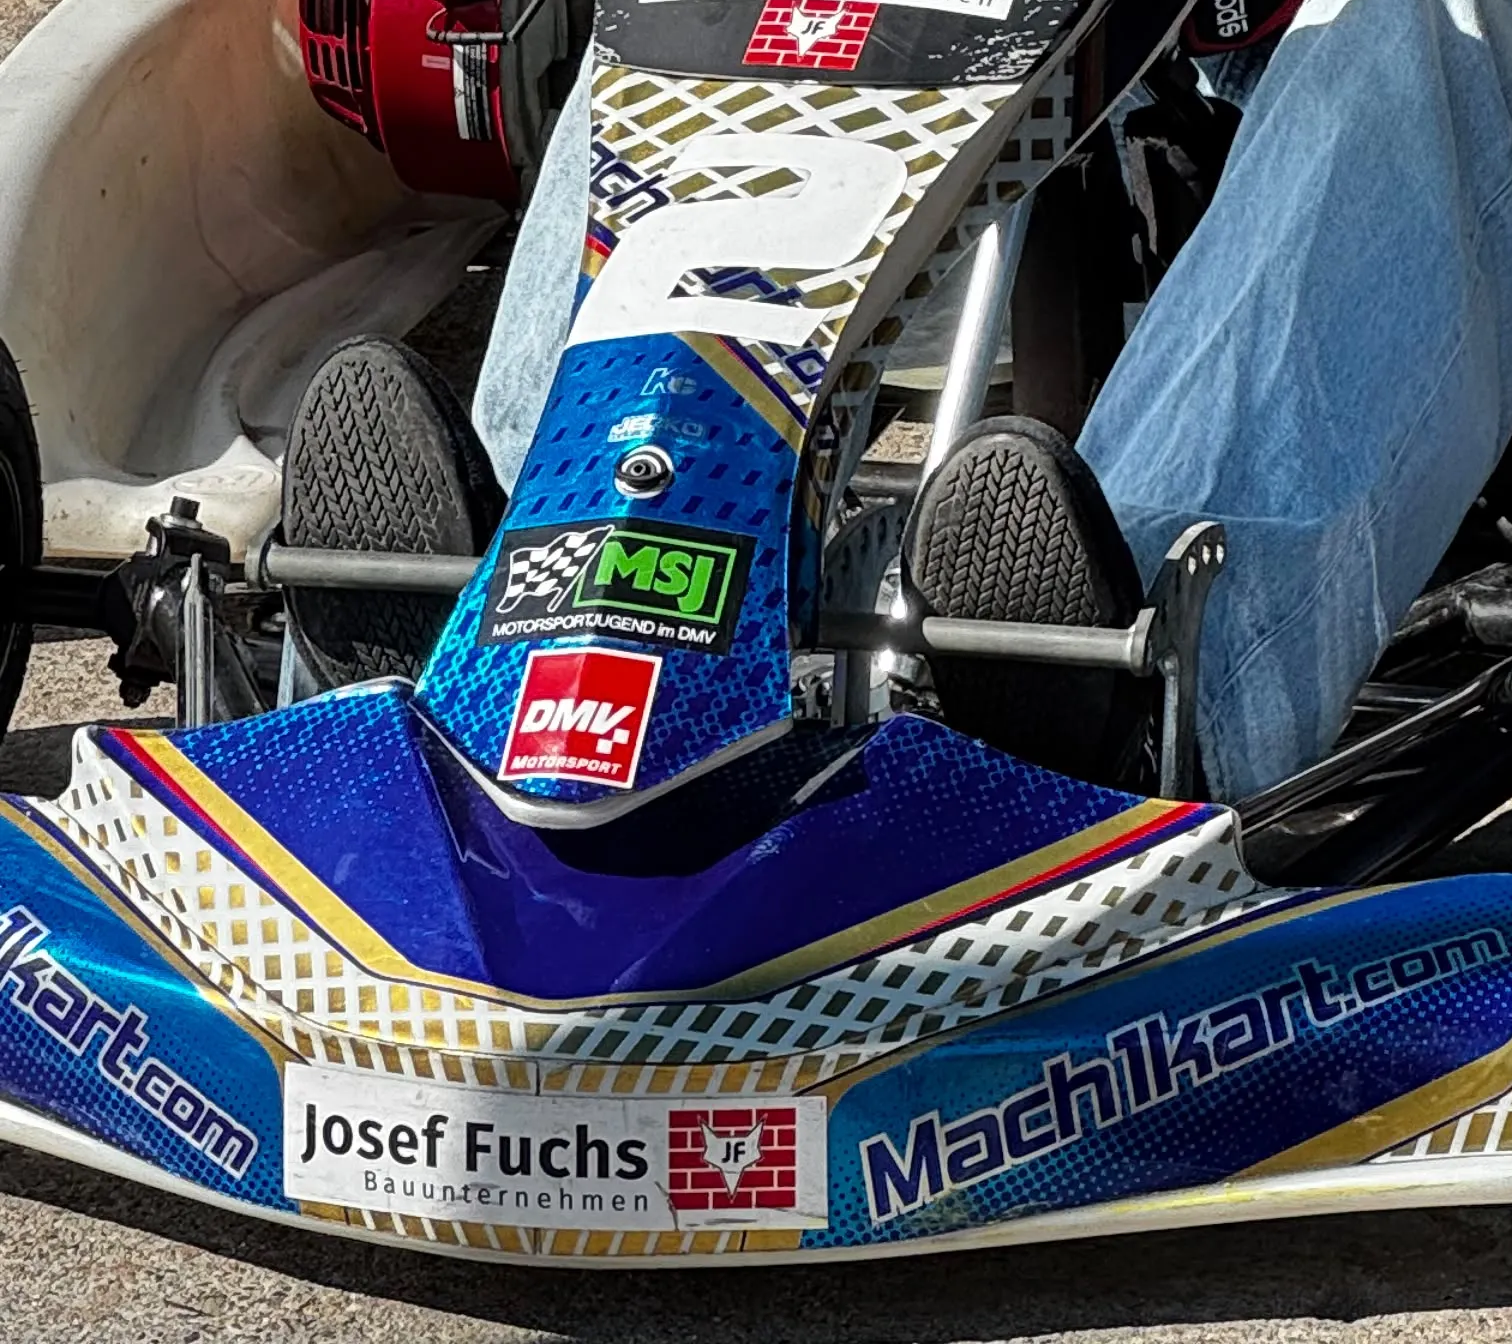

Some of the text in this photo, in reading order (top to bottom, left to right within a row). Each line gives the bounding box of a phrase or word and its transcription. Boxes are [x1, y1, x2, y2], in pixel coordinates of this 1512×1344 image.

[800, 20, 827, 35] JF
[594, 541, 715, 612] MSJ
[492, 612, 717, 645] MOTORSPORTJUGEND im DMV
[519, 698, 637, 735] DMV
[510, 755, 622, 775] MOTORSPORT
[860, 929, 1507, 1226] Mach1kart.com
[301, 1103, 648, 1180] Josef Fuchs
[722, 1139, 746, 1163] JF
[364, 1170, 648, 1212] Bauunternehmen
